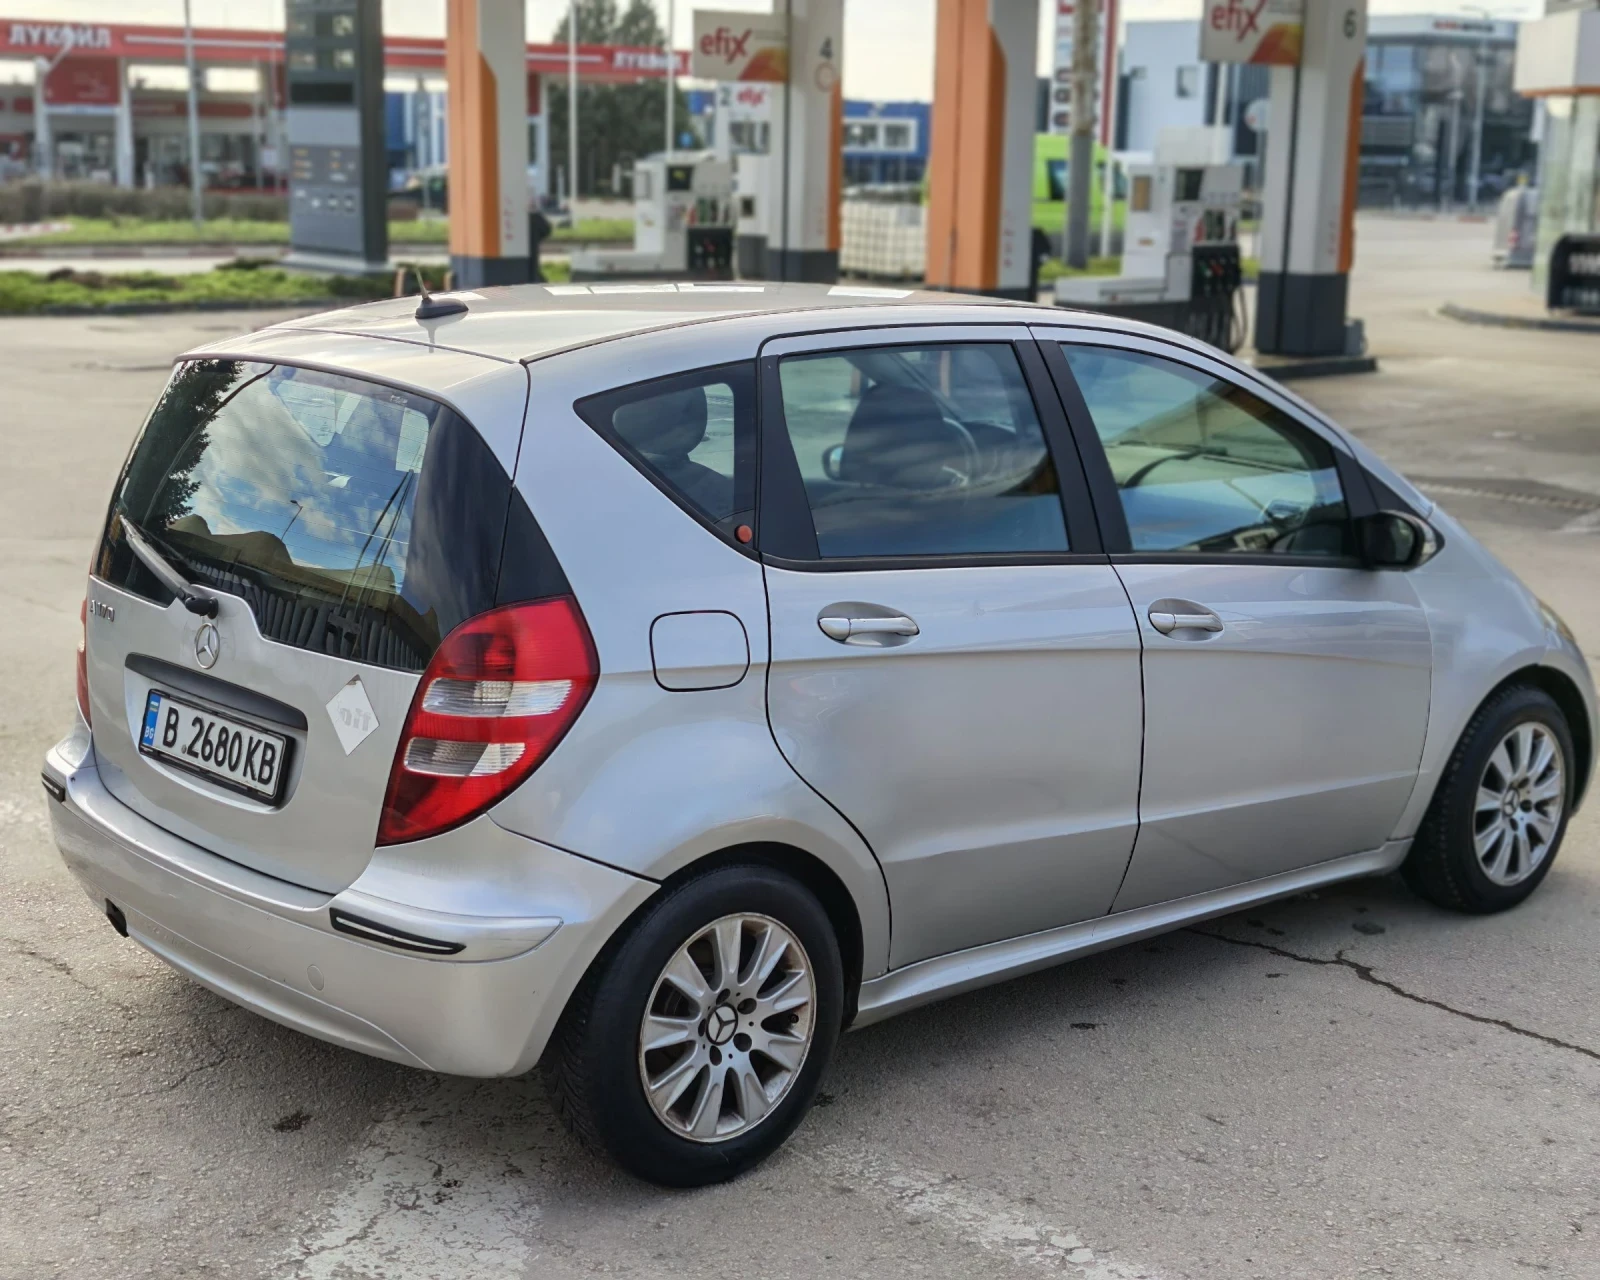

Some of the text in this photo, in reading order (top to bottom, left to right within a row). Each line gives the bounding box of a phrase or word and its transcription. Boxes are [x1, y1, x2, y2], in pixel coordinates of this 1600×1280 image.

[1210, 0, 1267, 43] efix
[1343, 9, 1358, 39] 6
[699, 27, 753, 64] efix
[819, 37, 833, 60] 4
[144, 726, 155, 740] BG
